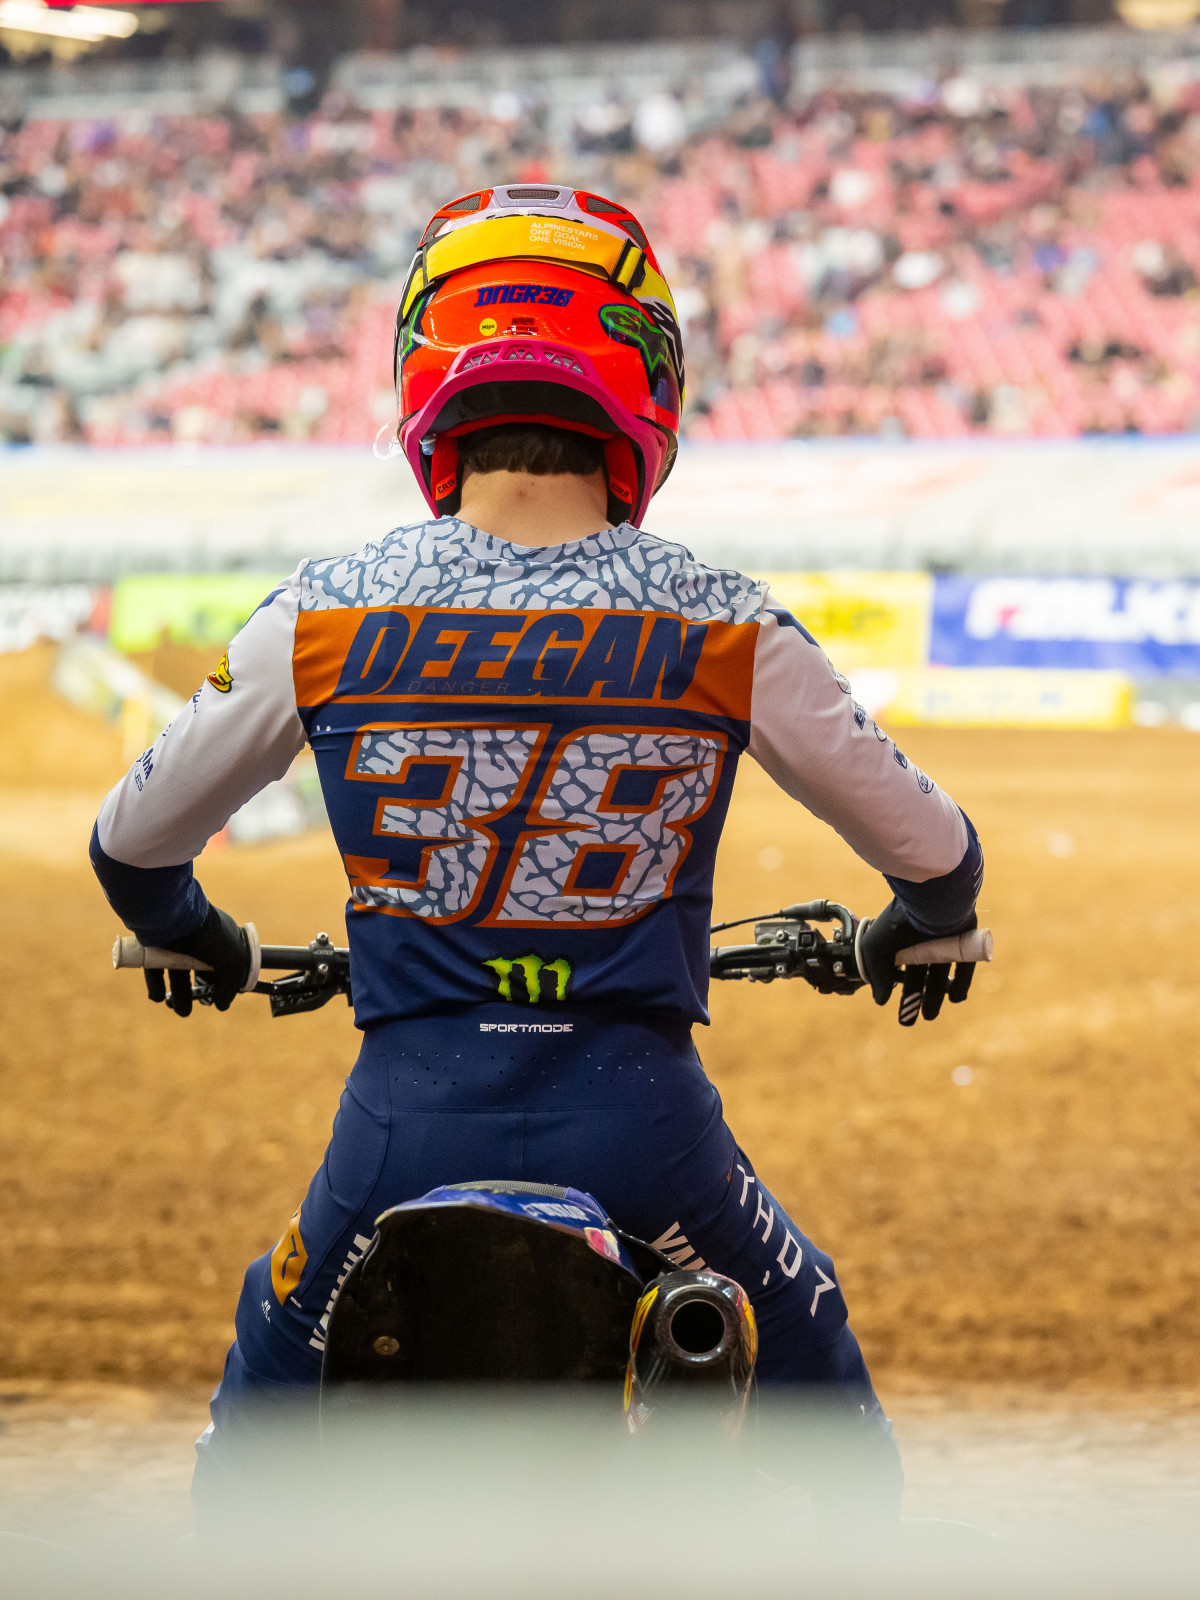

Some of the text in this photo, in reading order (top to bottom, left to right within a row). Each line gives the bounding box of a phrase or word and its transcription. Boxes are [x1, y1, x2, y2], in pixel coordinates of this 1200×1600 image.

[529, 228, 583, 243] ONE GOAL
[530, 222, 599, 241] ALPINESTARS
[528, 235, 586, 250] ONE VISION
[332, 611, 710, 701] DEEGAN
[407, 680, 512, 695] DANGER
[343, 720, 729, 930] 38
[479, 1023, 574, 1033] SPORTMODE
